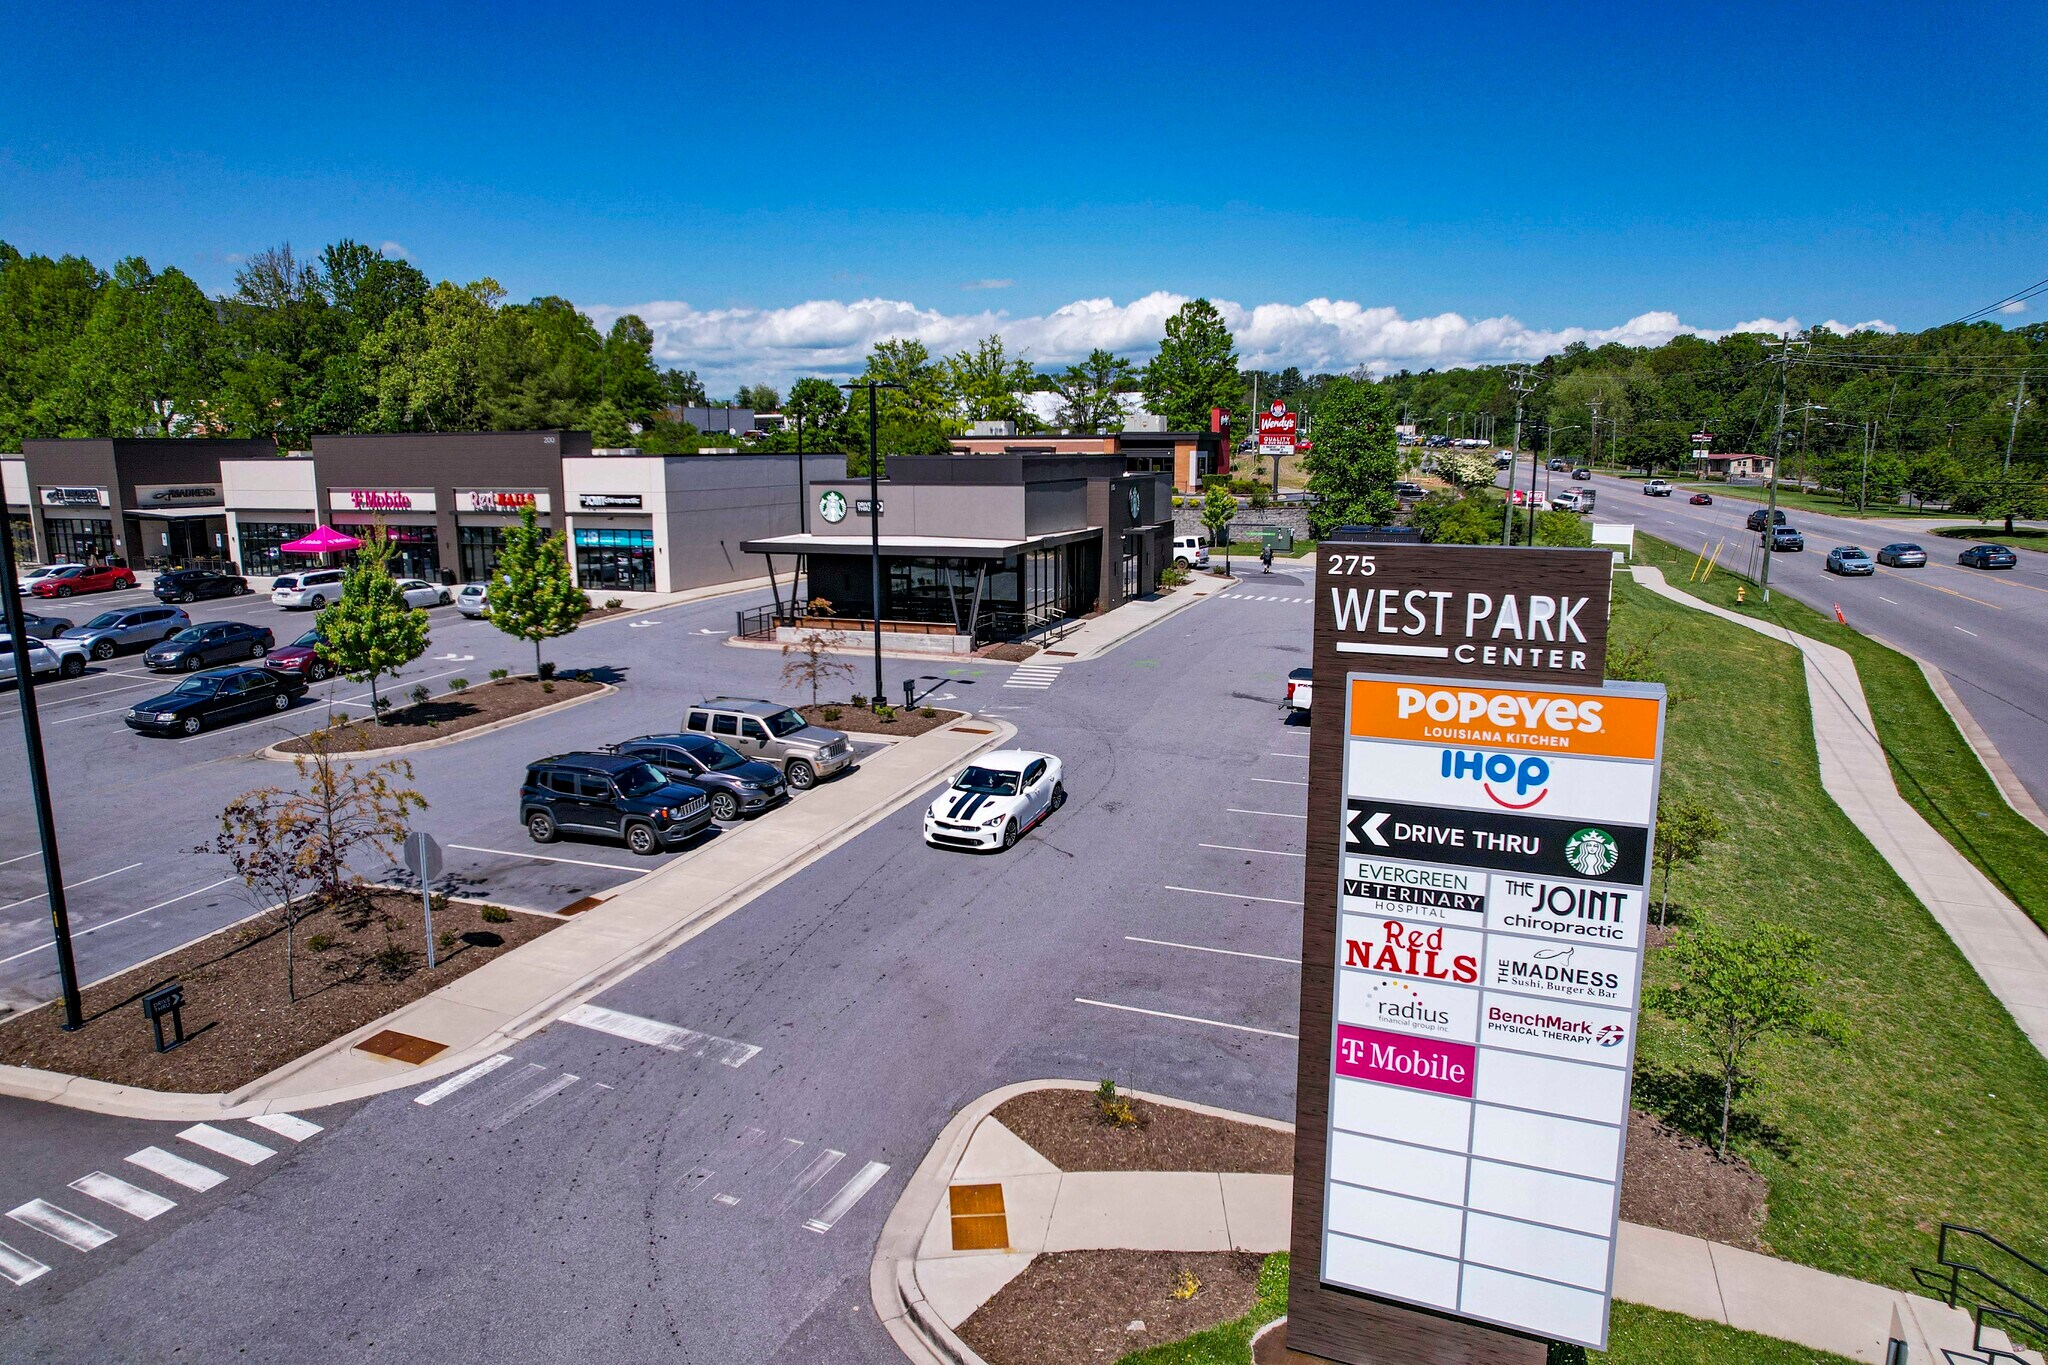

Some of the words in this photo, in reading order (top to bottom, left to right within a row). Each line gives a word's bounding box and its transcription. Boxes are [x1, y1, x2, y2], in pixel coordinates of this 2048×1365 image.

[1261, 416, 1294, 430] Wendy's
[543, 436, 555, 444] 200
[468, 490, 495, 508] Red
[1328, 555, 1376, 576] 275
[1331, 587, 1453, 636] WEST
[1465, 592, 1590, 643] PARK
[1454, 644, 1587, 670] CENTER
[1424, 726, 1502, 742] LOUISIANA
[1506, 733, 1570, 747] KITCHEN
[1441, 749, 1550, 795] IHOP
[1394, 822, 1465, 847] DRIVE
[1472, 830, 1540, 855] THRU
[1359, 863, 1468, 890] EVERGREEN
[1345, 880, 1480, 910] VETERINARY
[1505, 880, 1534, 897] THE
[1532, 884, 1628, 923] JOINT
[1375, 901, 1446, 918] HOSPITAL
[1383, 920, 1443, 950] Red
[1503, 914, 1624, 939] chiropractic
[1345, 939, 1478, 983] NAILS
[1498, 959, 1510, 983] THE
[1512, 961, 1619, 988] MADNESS
[1511, 977, 1544, 989] Sushi,
[1547, 981, 1585, 995] Burger
[1587, 988, 1596, 996] &
[1598, 988, 1618, 999] Bar
[153, 997, 170, 1008] DRIVE
[154, 1002, 170, 1012] THRU
[1378, 1001, 1449, 1025] radius
[1378, 1015, 1411, 1027] financial
[1411, 1021, 1436, 1031] group
[1488, 1007, 1593, 1035] BenchMark
[1488, 1022, 1539, 1037] PHYSICAL
[1542, 1030, 1592, 1044] THERAPY
[1368, 1042, 1466, 1083] Mobile
